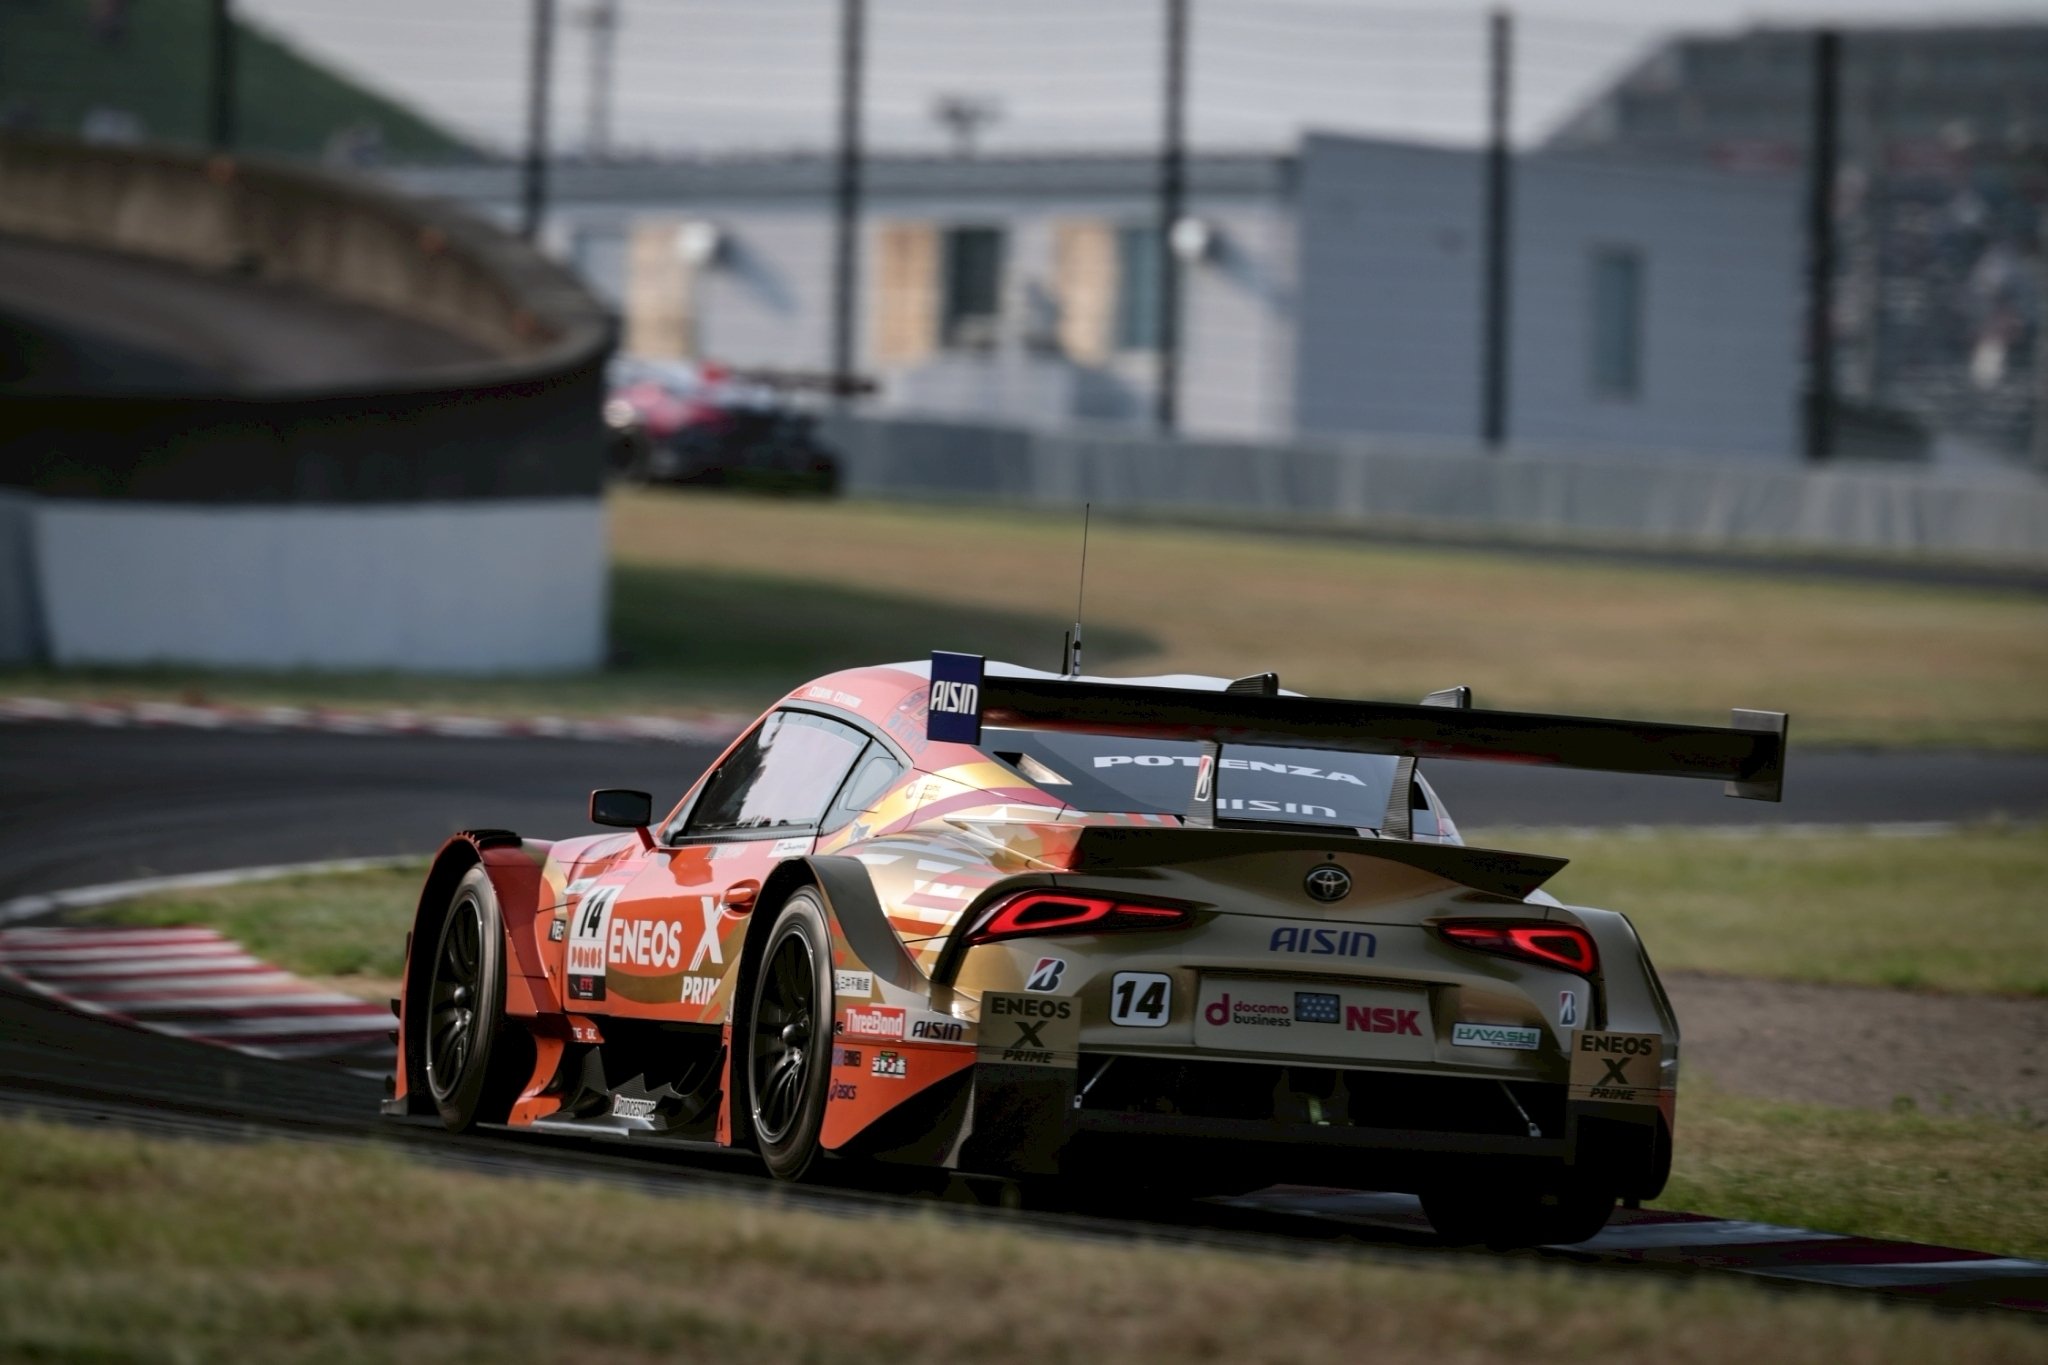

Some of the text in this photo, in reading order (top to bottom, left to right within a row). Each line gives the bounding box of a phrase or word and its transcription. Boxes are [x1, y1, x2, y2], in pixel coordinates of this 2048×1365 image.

[930, 681, 978, 715] AISIN
[1094, 755, 1368, 786] POTENZA
[579, 888, 616, 937] 14
[609, 918, 682, 968] ENEOS
[688, 896, 724, 971] X
[1269, 927, 1377, 958] AISIN
[991, 997, 1071, 1019] ENEOS
[1117, 980, 1167, 1019] 14
[1233, 1000, 1289, 1014] docomo
[846, 1009, 904, 1036] ThreeBond
[912, 1021, 963, 1041] AISIN
[1011, 1020, 1049, 1049] X
[1233, 1013, 1291, 1027] business
[1346, 1005, 1423, 1036] NSK
[1455, 1027, 1536, 1043] HAYASHI
[1581, 1034, 1652, 1056] ENEOS
[1002, 1049, 1053, 1064] PRIME
[1597, 1057, 1632, 1087] X
[1590, 1087, 1637, 1100] PRIME
